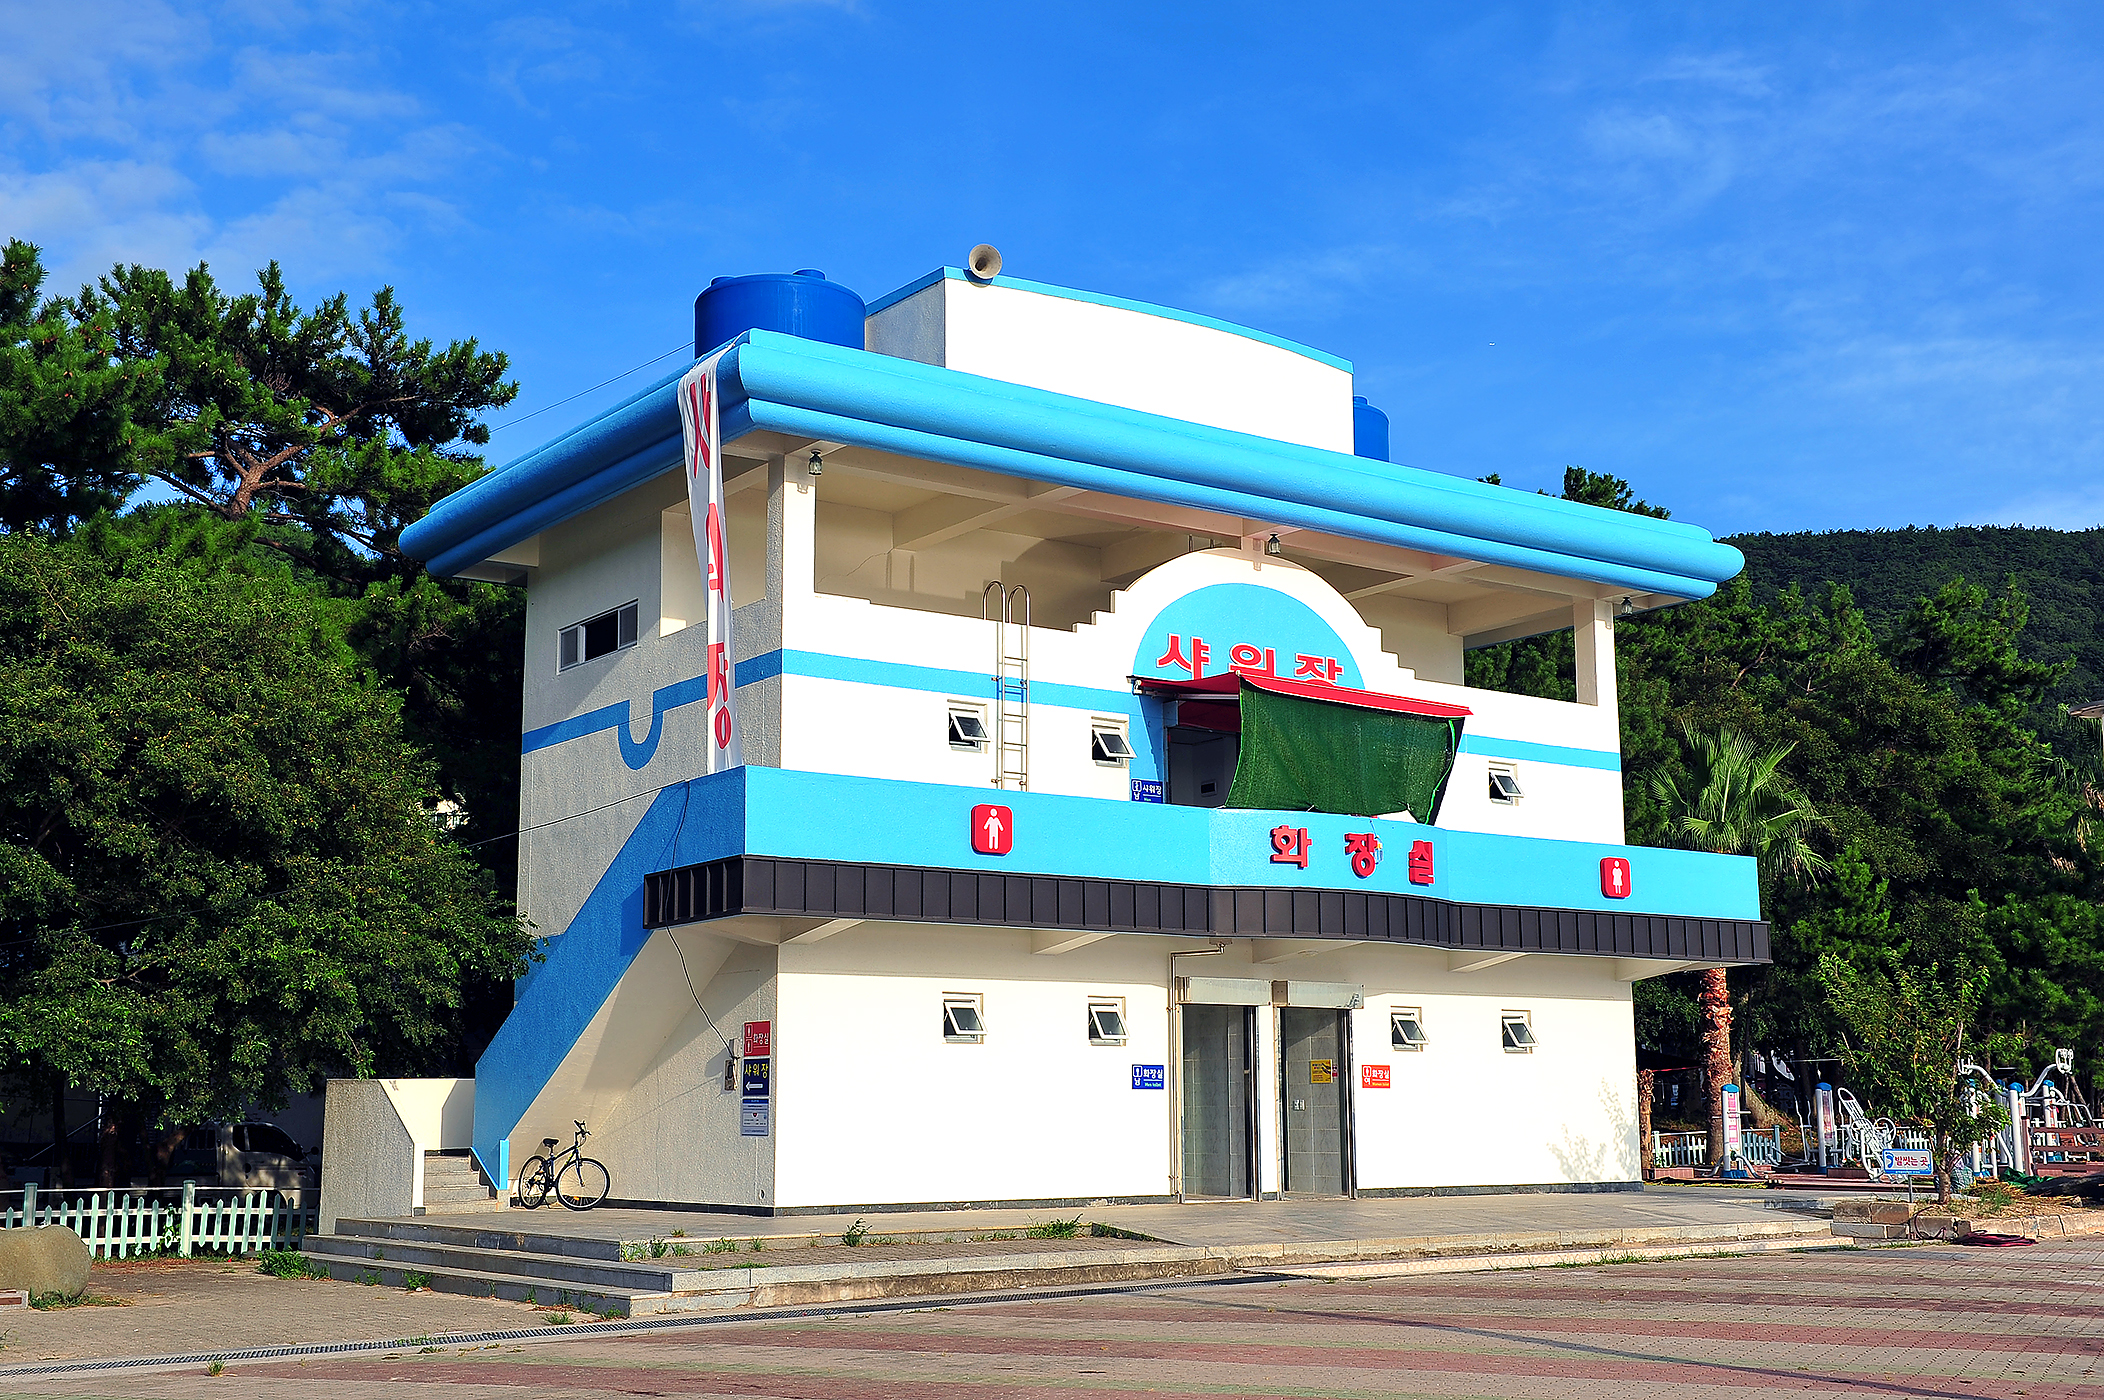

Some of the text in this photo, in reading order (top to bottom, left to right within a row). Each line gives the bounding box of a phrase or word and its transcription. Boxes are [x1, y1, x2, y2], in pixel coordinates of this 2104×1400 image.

[1133, 791, 1141, 800] 남
[1270, 825, 1435, 886] 화장실
[753, 1033, 769, 1045] 화장실
[744, 1063, 769, 1079] 샤워장
[1143, 1068, 1163, 1079] 화장실
[1372, 1069, 1390, 1079] 화장실
[1134, 1077, 1141, 1086] 남
[1363, 1077, 1371, 1086] 여
[1894, 1156, 1929, 1167] 발씻는 곳
